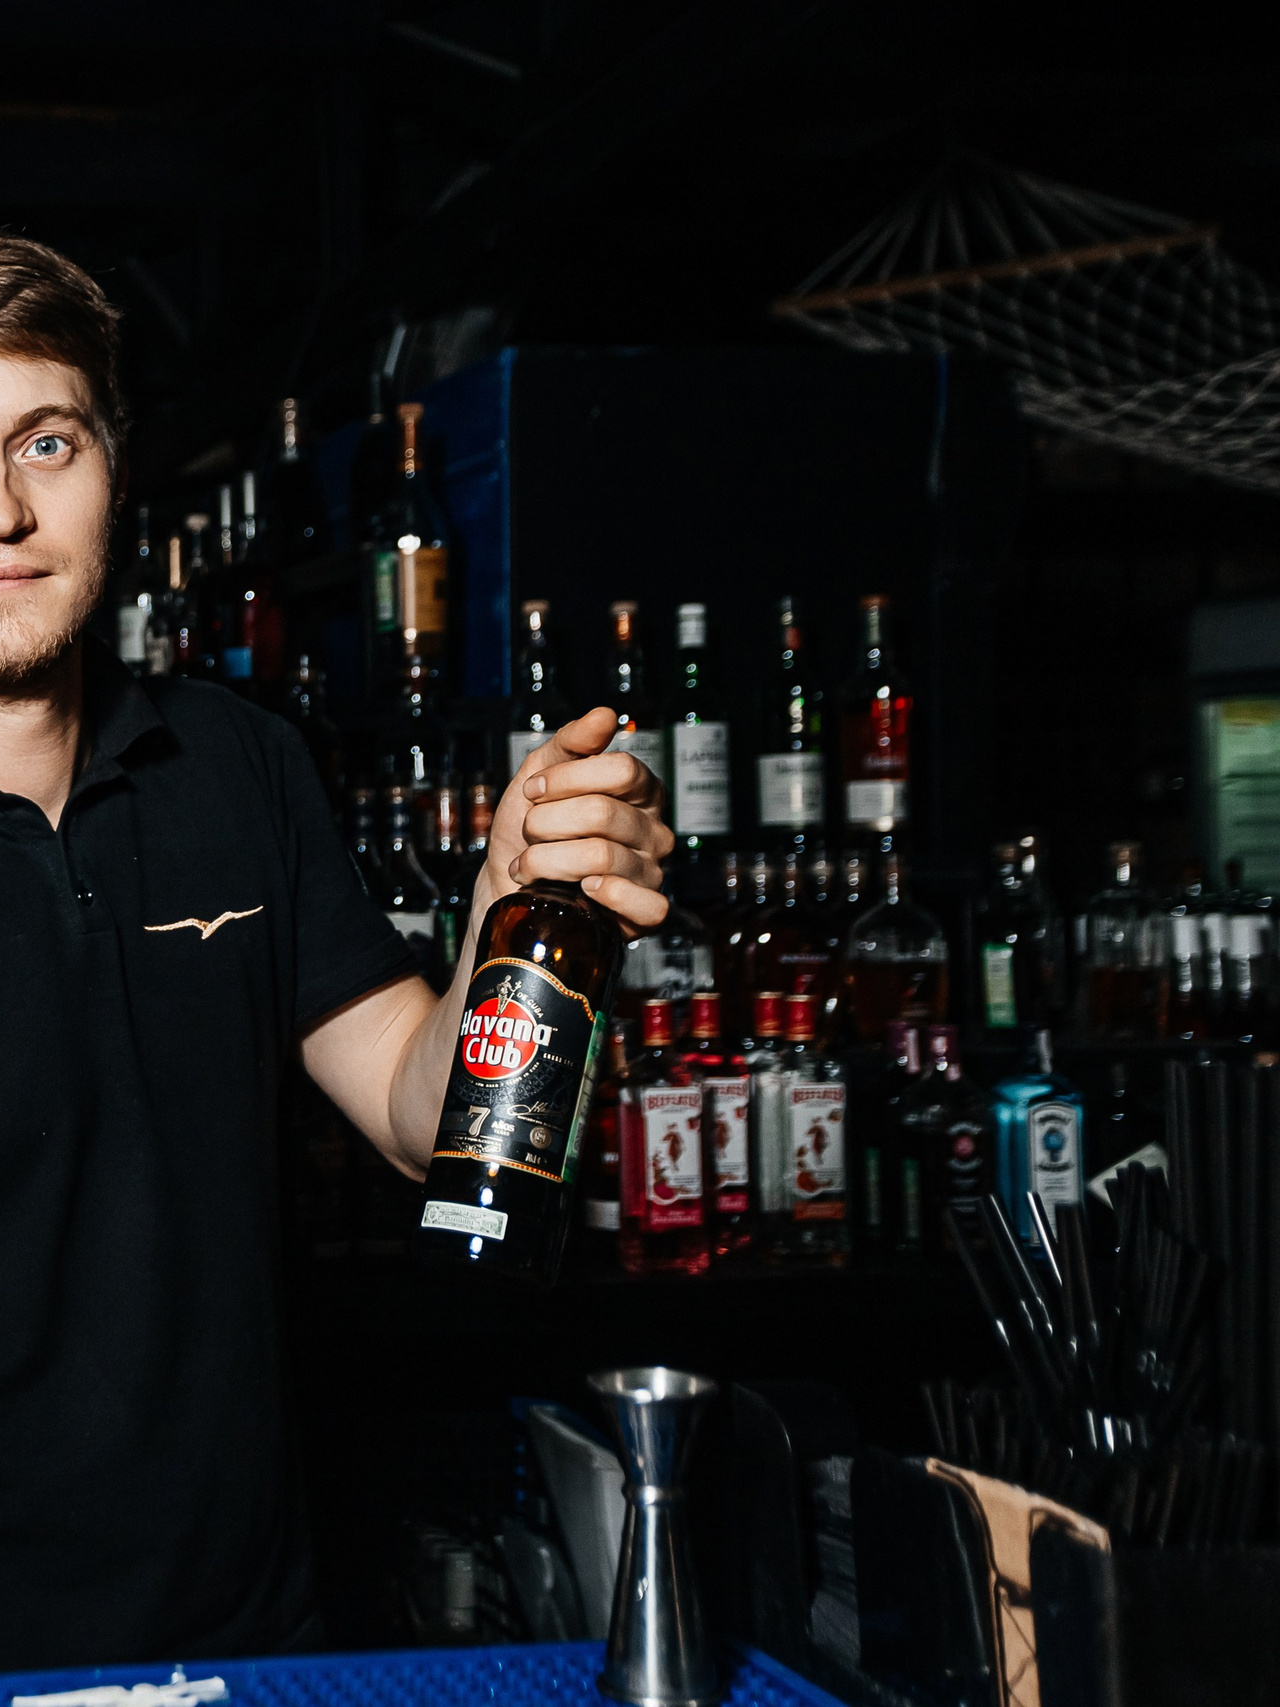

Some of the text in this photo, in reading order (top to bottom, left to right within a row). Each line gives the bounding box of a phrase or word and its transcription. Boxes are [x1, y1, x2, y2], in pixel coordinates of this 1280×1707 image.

[528, 1000, 544, 1018] CUBA
[460, 1009, 552, 1046] Havana
[465, 1037, 521, 1069] Club
[467, 1105, 491, 1137] 7
[491, 1120, 515, 1132] AÑOS
